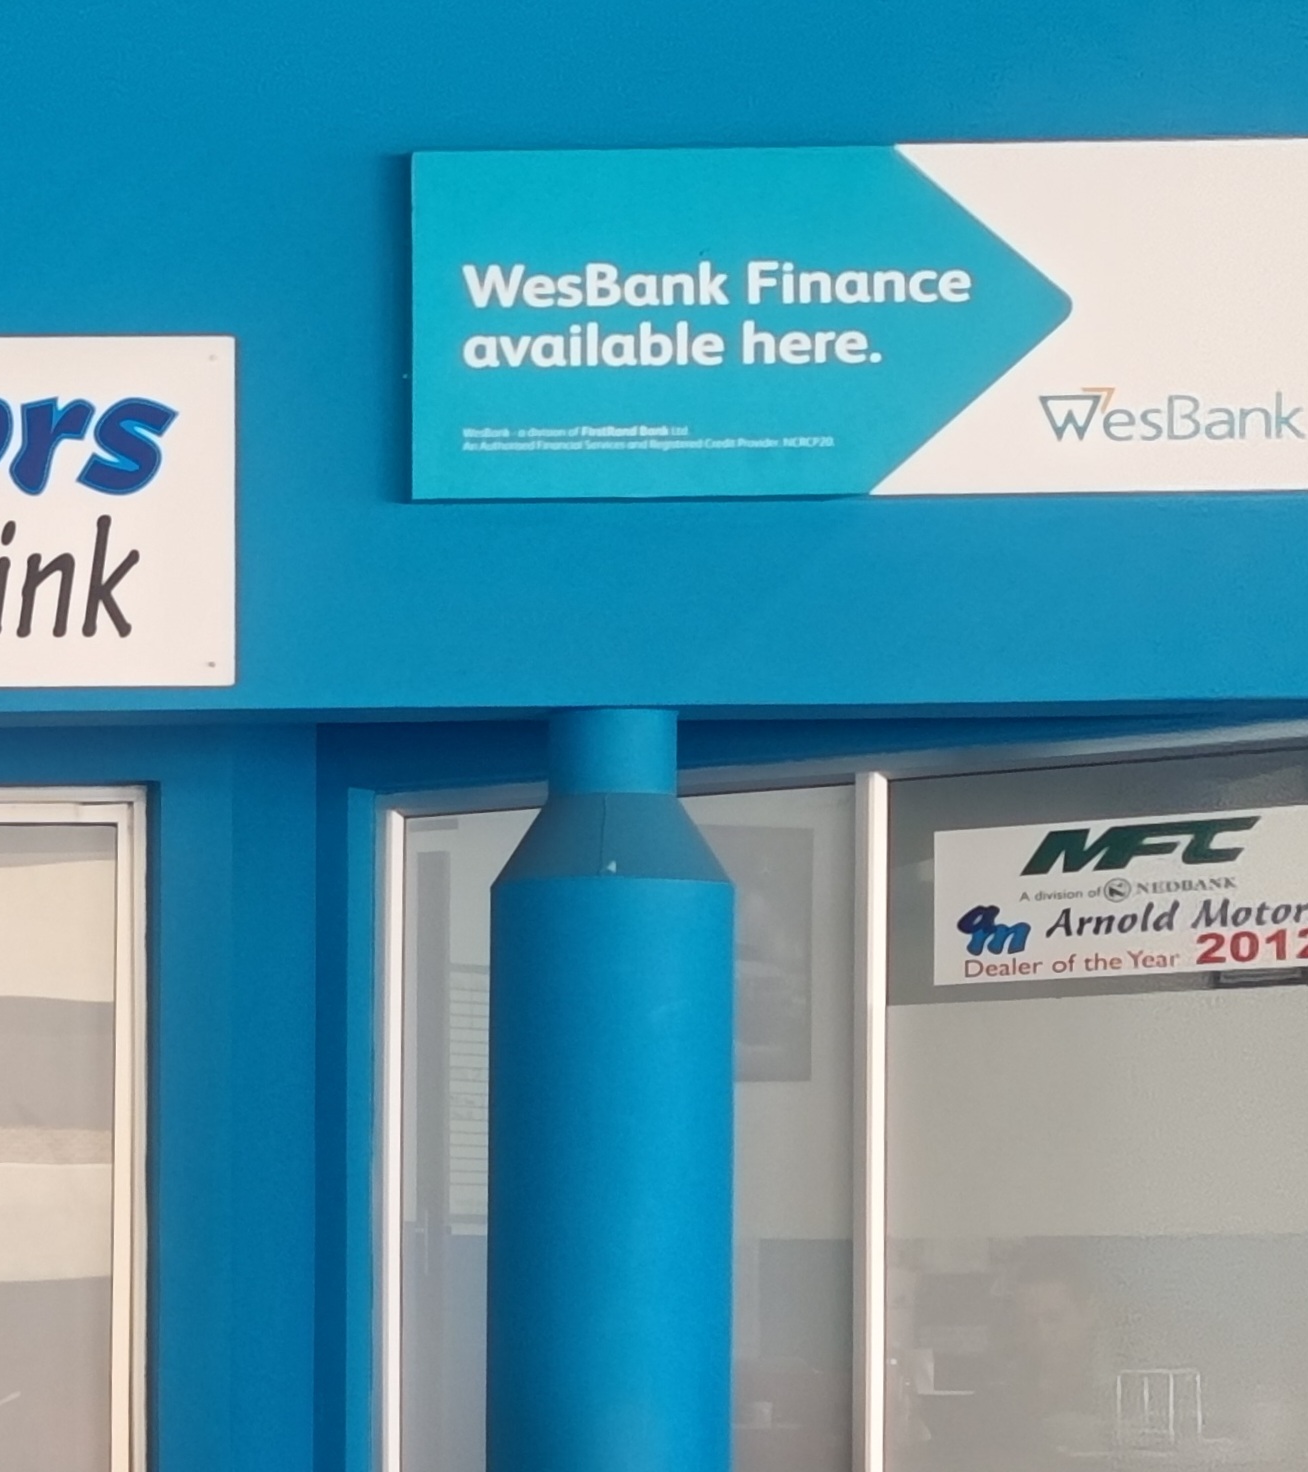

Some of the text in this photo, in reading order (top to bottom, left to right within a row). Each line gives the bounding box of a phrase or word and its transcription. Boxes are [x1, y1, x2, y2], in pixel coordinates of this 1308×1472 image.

[462, 259, 973, 309] WesBank Finance
[462, 319, 883, 369] available here.
[580, 425, 638, 437] FirstRand
[639, 425, 669, 437] Bank
[1038, 386, 1307, 442] WesBank
[1020, 816, 1261, 876] MFC
[1019, 892, 1030, 902] A
[1034, 890, 1083, 902] division
[1088, 887, 1101, 898] of
[1136, 876, 1238, 895] NEDBANK
[1045, 900, 1179, 938] Arnold
[964, 959, 1043, 978] Dealer
[1052, 954, 1078, 974] of
[1084, 953, 1123, 972] the
[1127, 950, 1181, 970] Year
